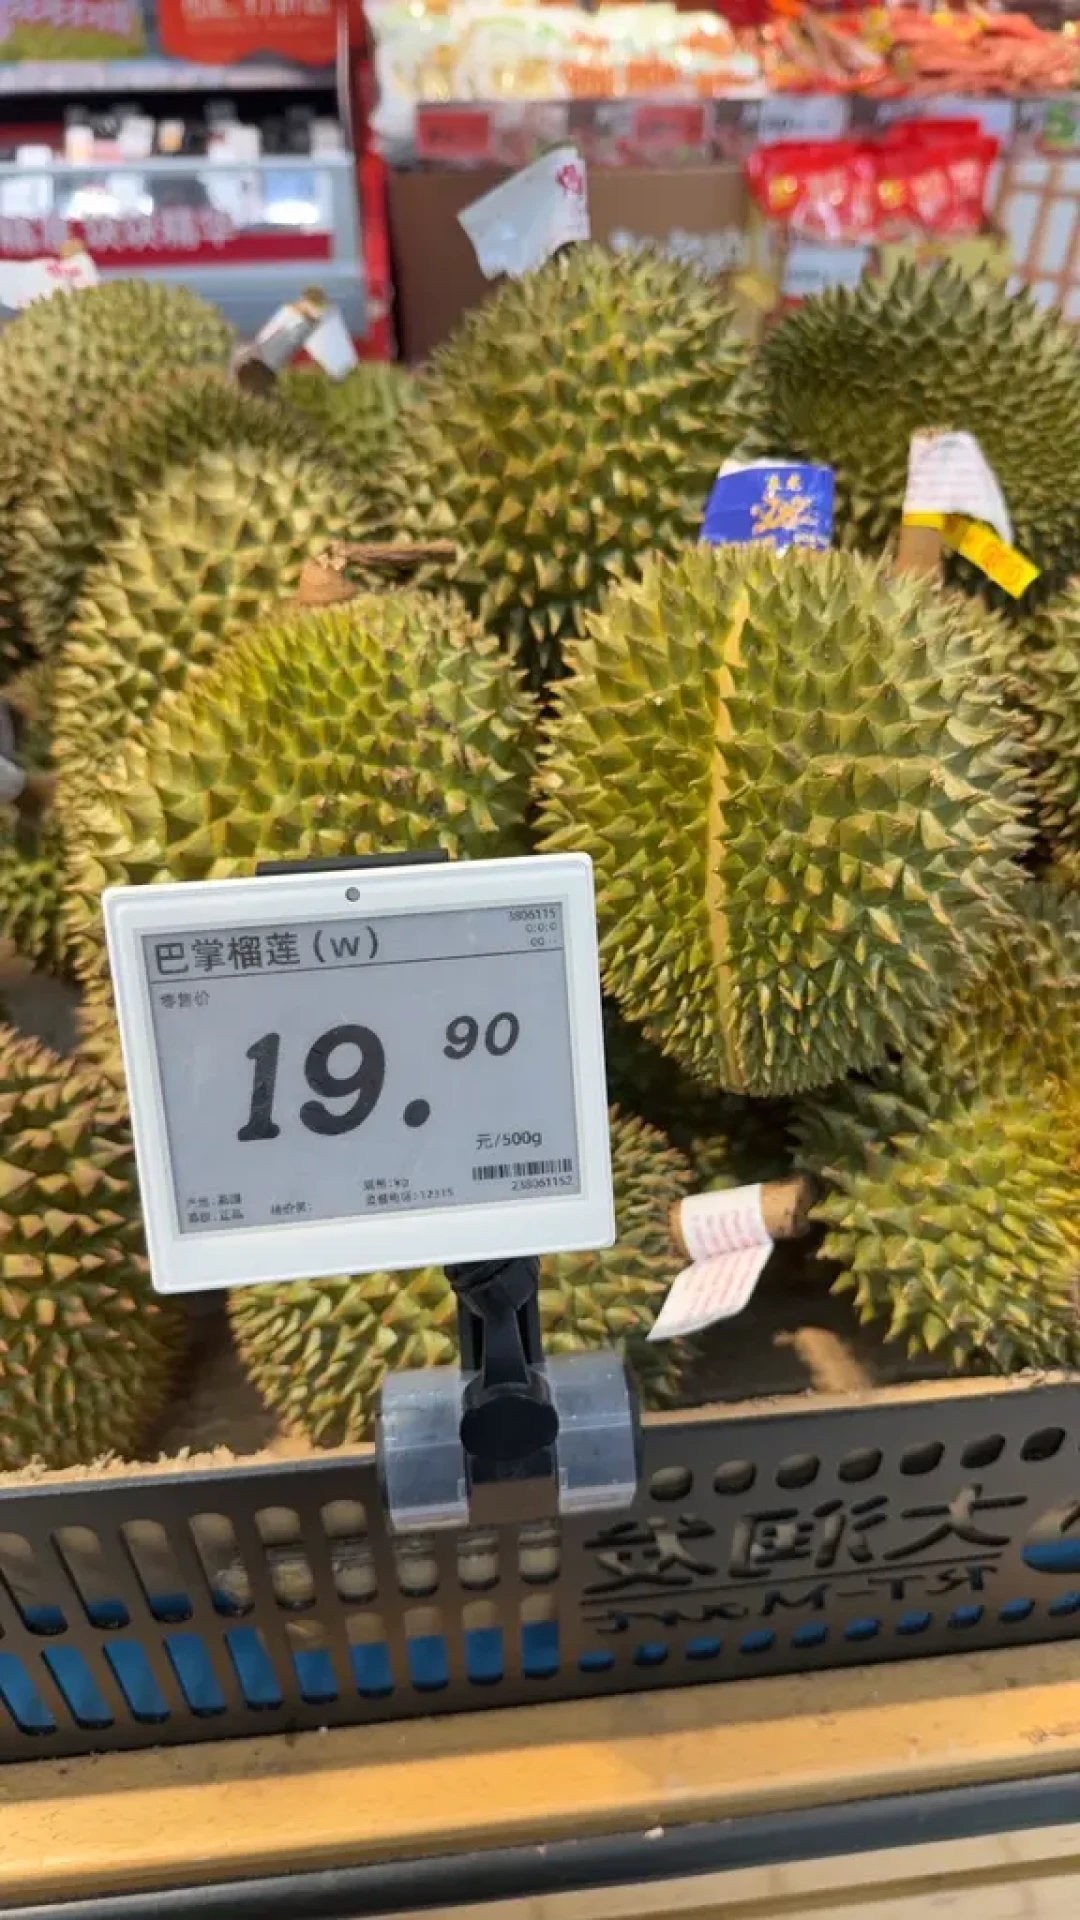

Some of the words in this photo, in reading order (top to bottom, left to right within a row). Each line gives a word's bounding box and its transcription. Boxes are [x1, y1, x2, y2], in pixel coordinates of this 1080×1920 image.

[160, 989, 211, 1009] 零售价
[475, 1130, 543, 1151] 元/500g
